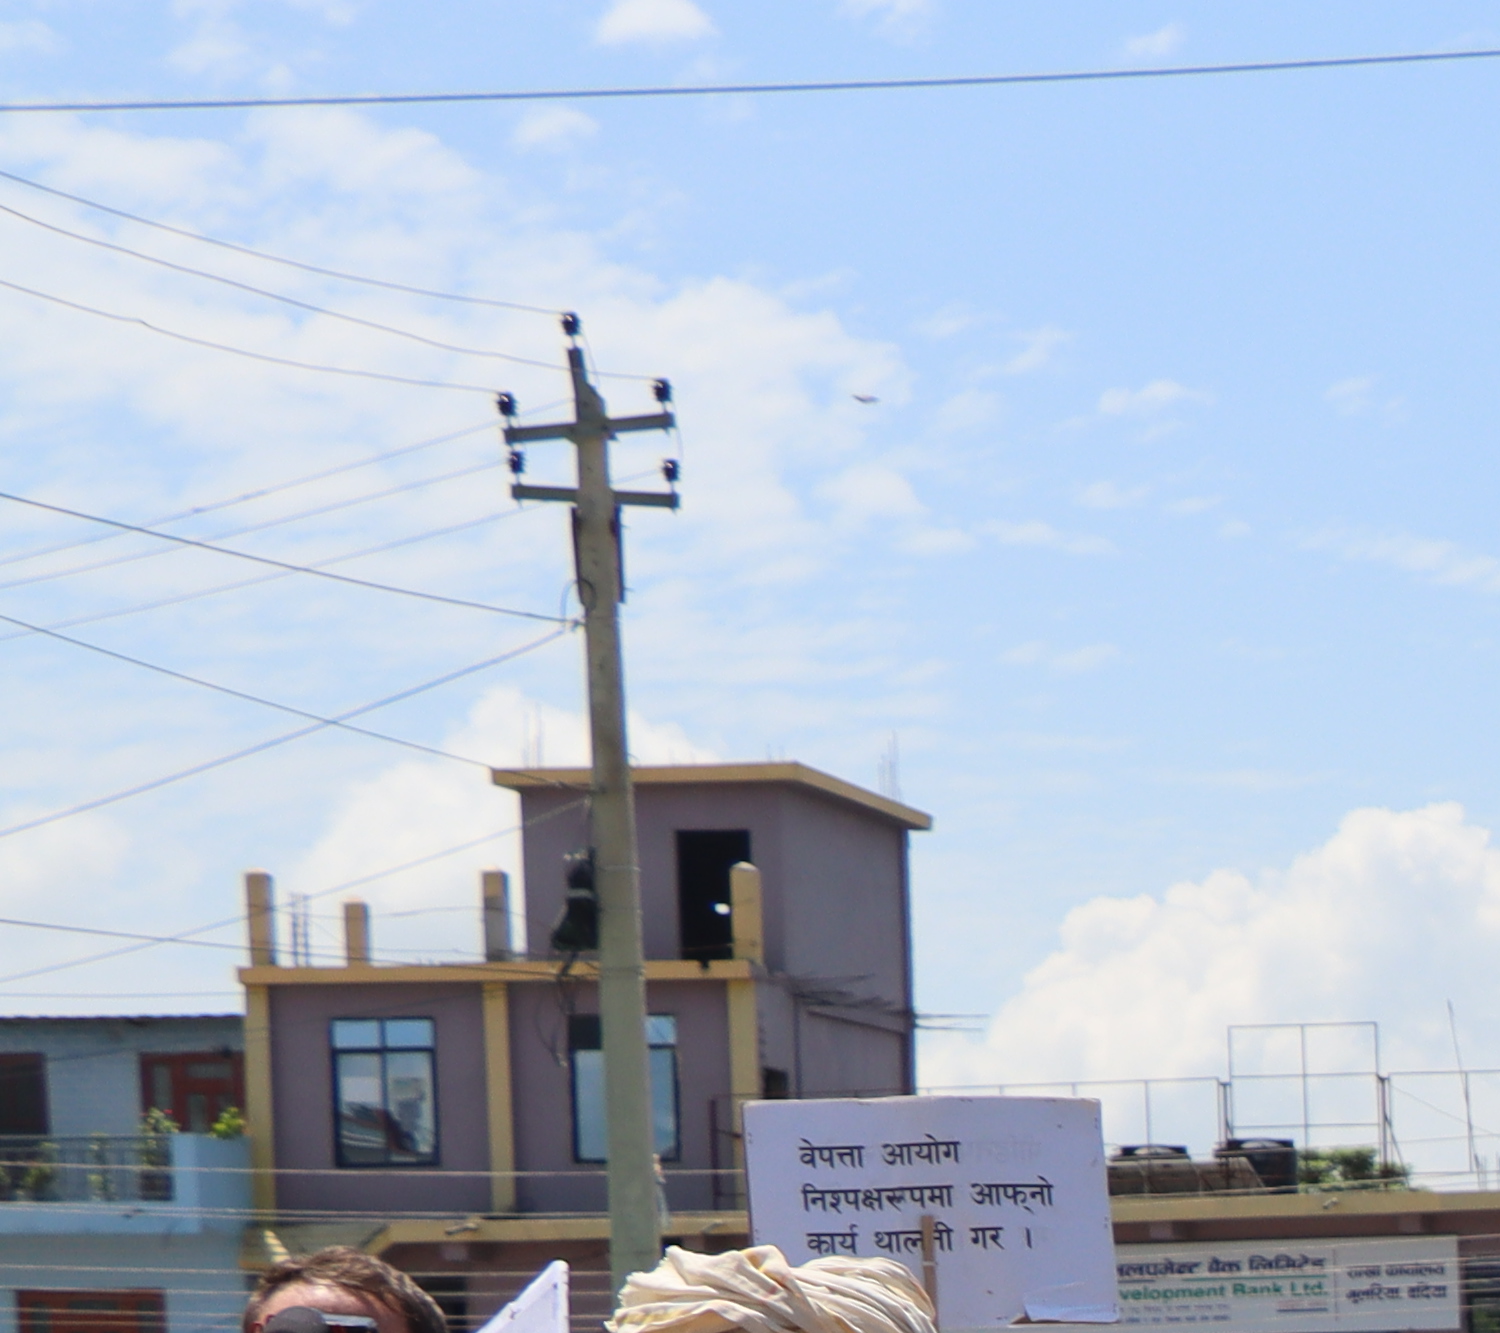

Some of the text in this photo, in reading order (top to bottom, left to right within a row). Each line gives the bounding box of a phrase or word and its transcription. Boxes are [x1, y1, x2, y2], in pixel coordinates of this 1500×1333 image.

[882, 1133, 960, 1166] आयोग
[807, 1223, 859, 1255] कार्य
[970, 1226, 1003, 1250] गर
[1118, 1280, 1330, 1302] velopment Bank Ltd.
